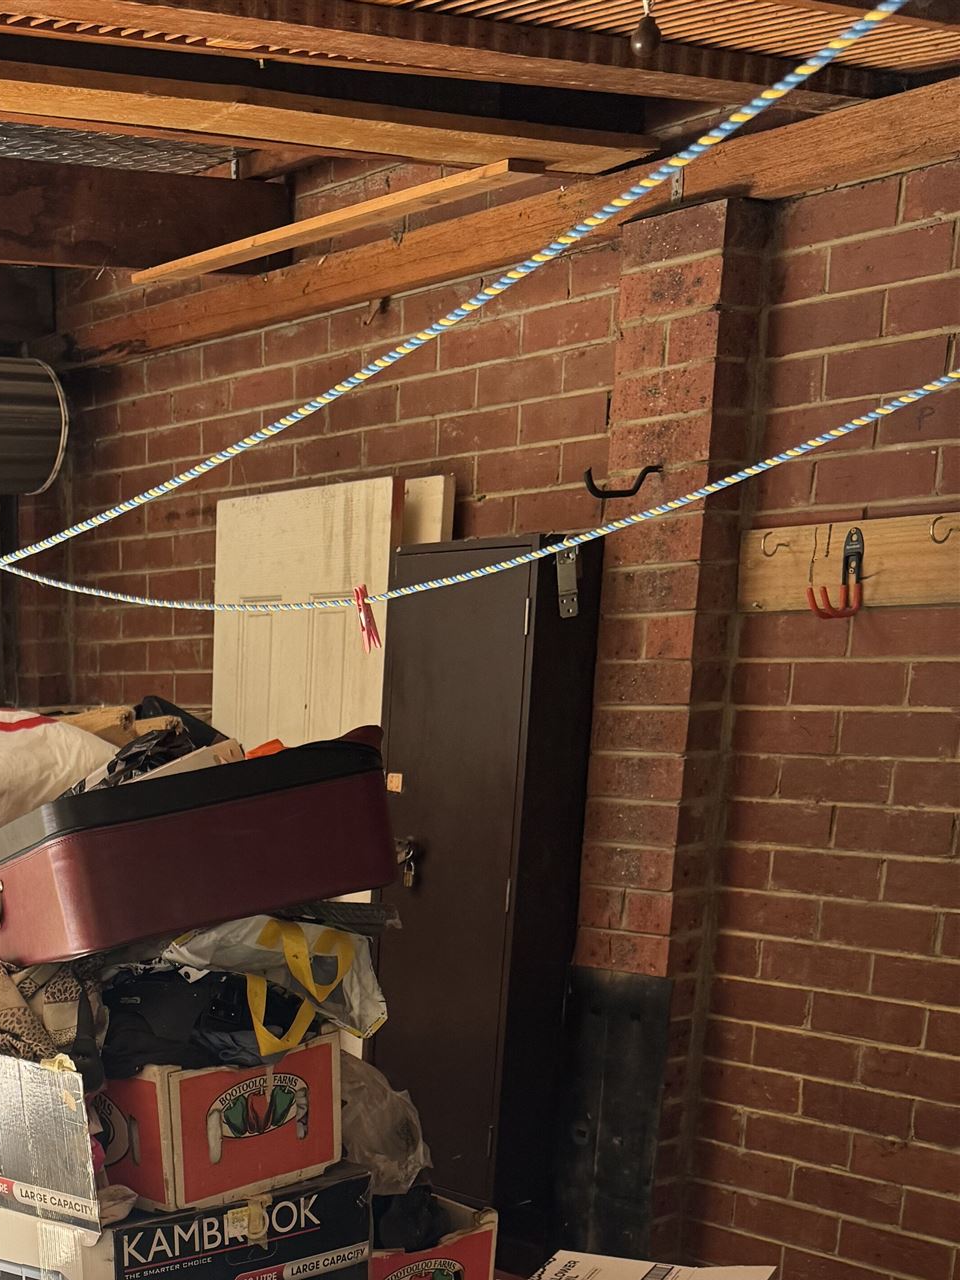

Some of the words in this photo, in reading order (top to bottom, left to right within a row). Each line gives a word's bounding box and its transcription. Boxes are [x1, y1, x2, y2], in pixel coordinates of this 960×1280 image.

[272, 1075, 299, 1088] FARMS
[20, 1188, 48, 1204] LARGE
[49, 1196, 93, 1216] CAPACITY
[124, 1272, 141, 1280] THE
[143, 1264, 180, 1277] SMARTER
[182, 1257, 213, 1269] CHOICE
[291, 1261, 320, 1276] LARGE
[323, 1247, 366, 1268] CAPACITY
[433, 1260, 457, 1271] FARMS
